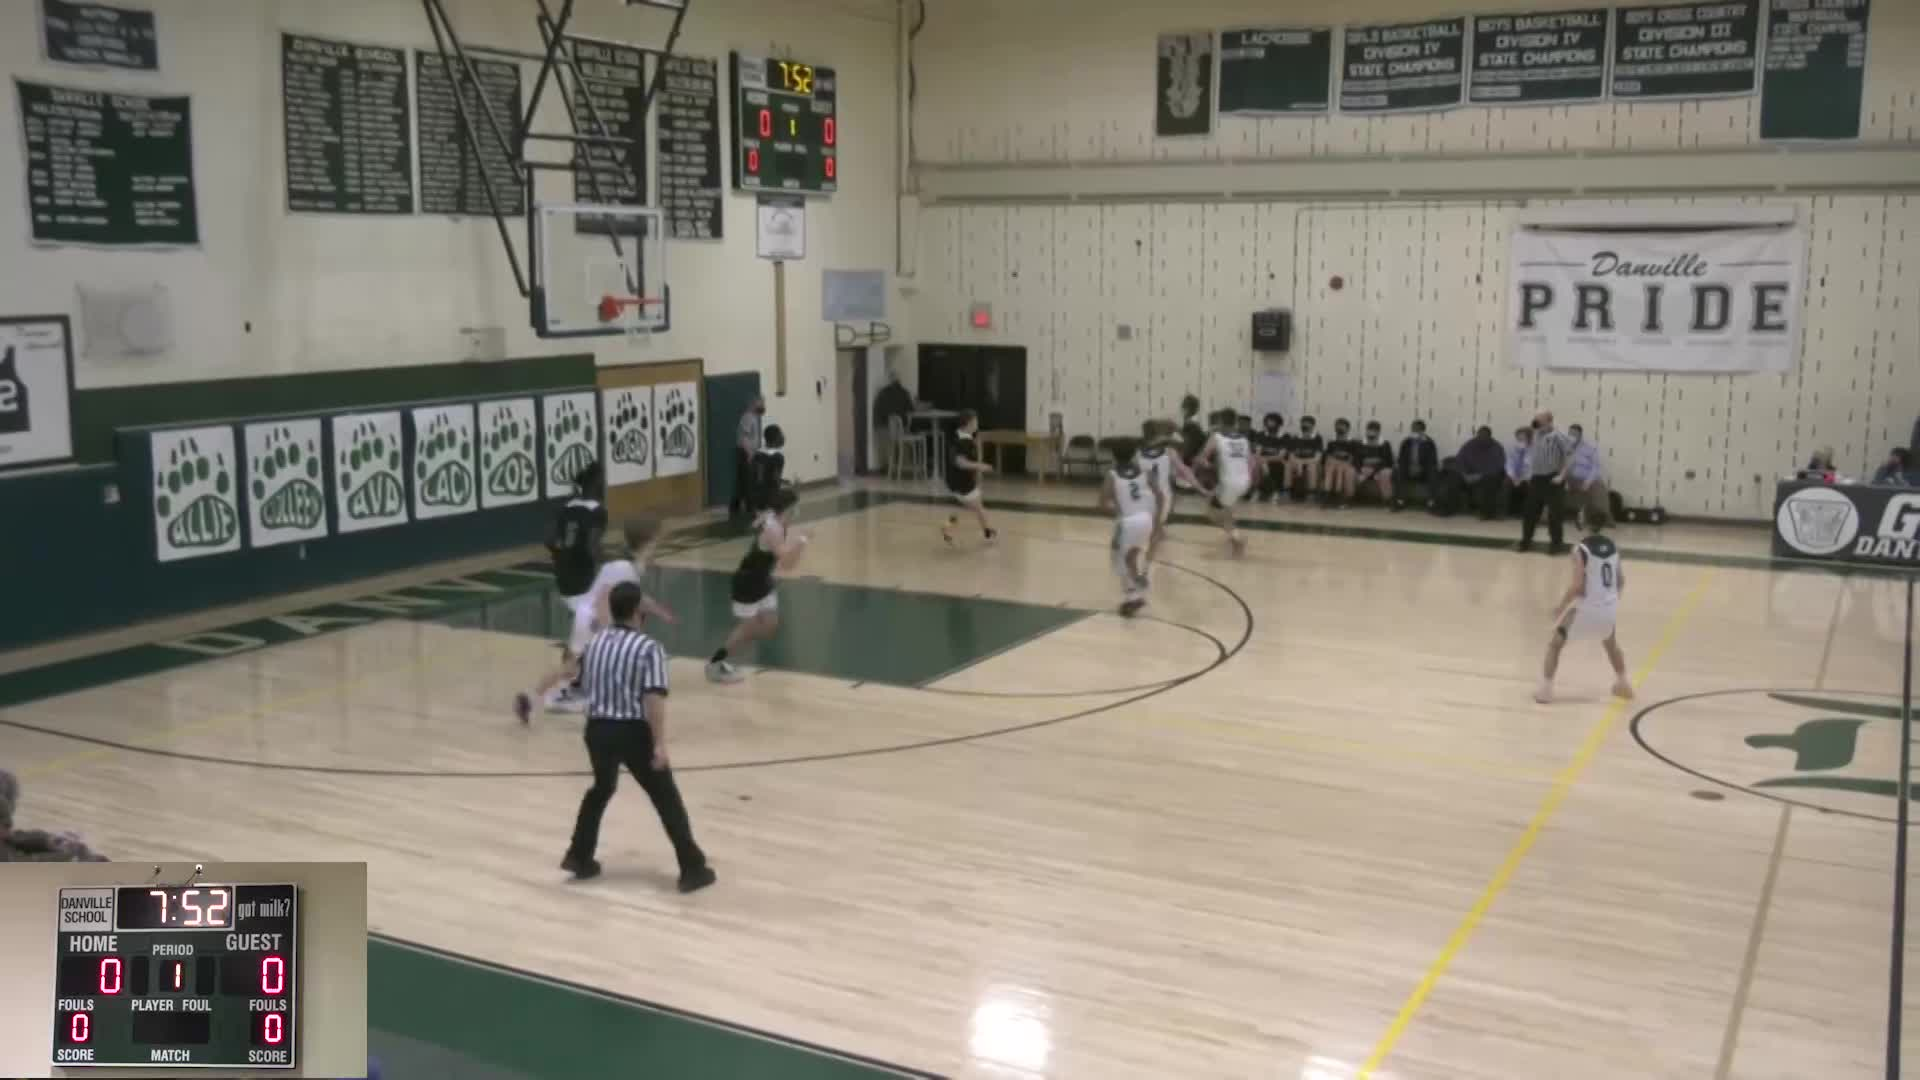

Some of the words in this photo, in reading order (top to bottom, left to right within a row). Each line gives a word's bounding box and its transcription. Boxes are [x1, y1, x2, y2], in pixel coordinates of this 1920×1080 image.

[760, 110, 771, 137] 0
[824, 118, 834, 144] 0
[749, 150, 759, 171] 0
[825, 157, 834, 177] 0
[1591, 251, 1708, 277] Danville
[1518, 281, 1789, 332] PRIDE
[350, 473, 402, 518] AVA
[1853, 536, 1920, 560] DAN
[1601, 562, 1612, 588] 0
